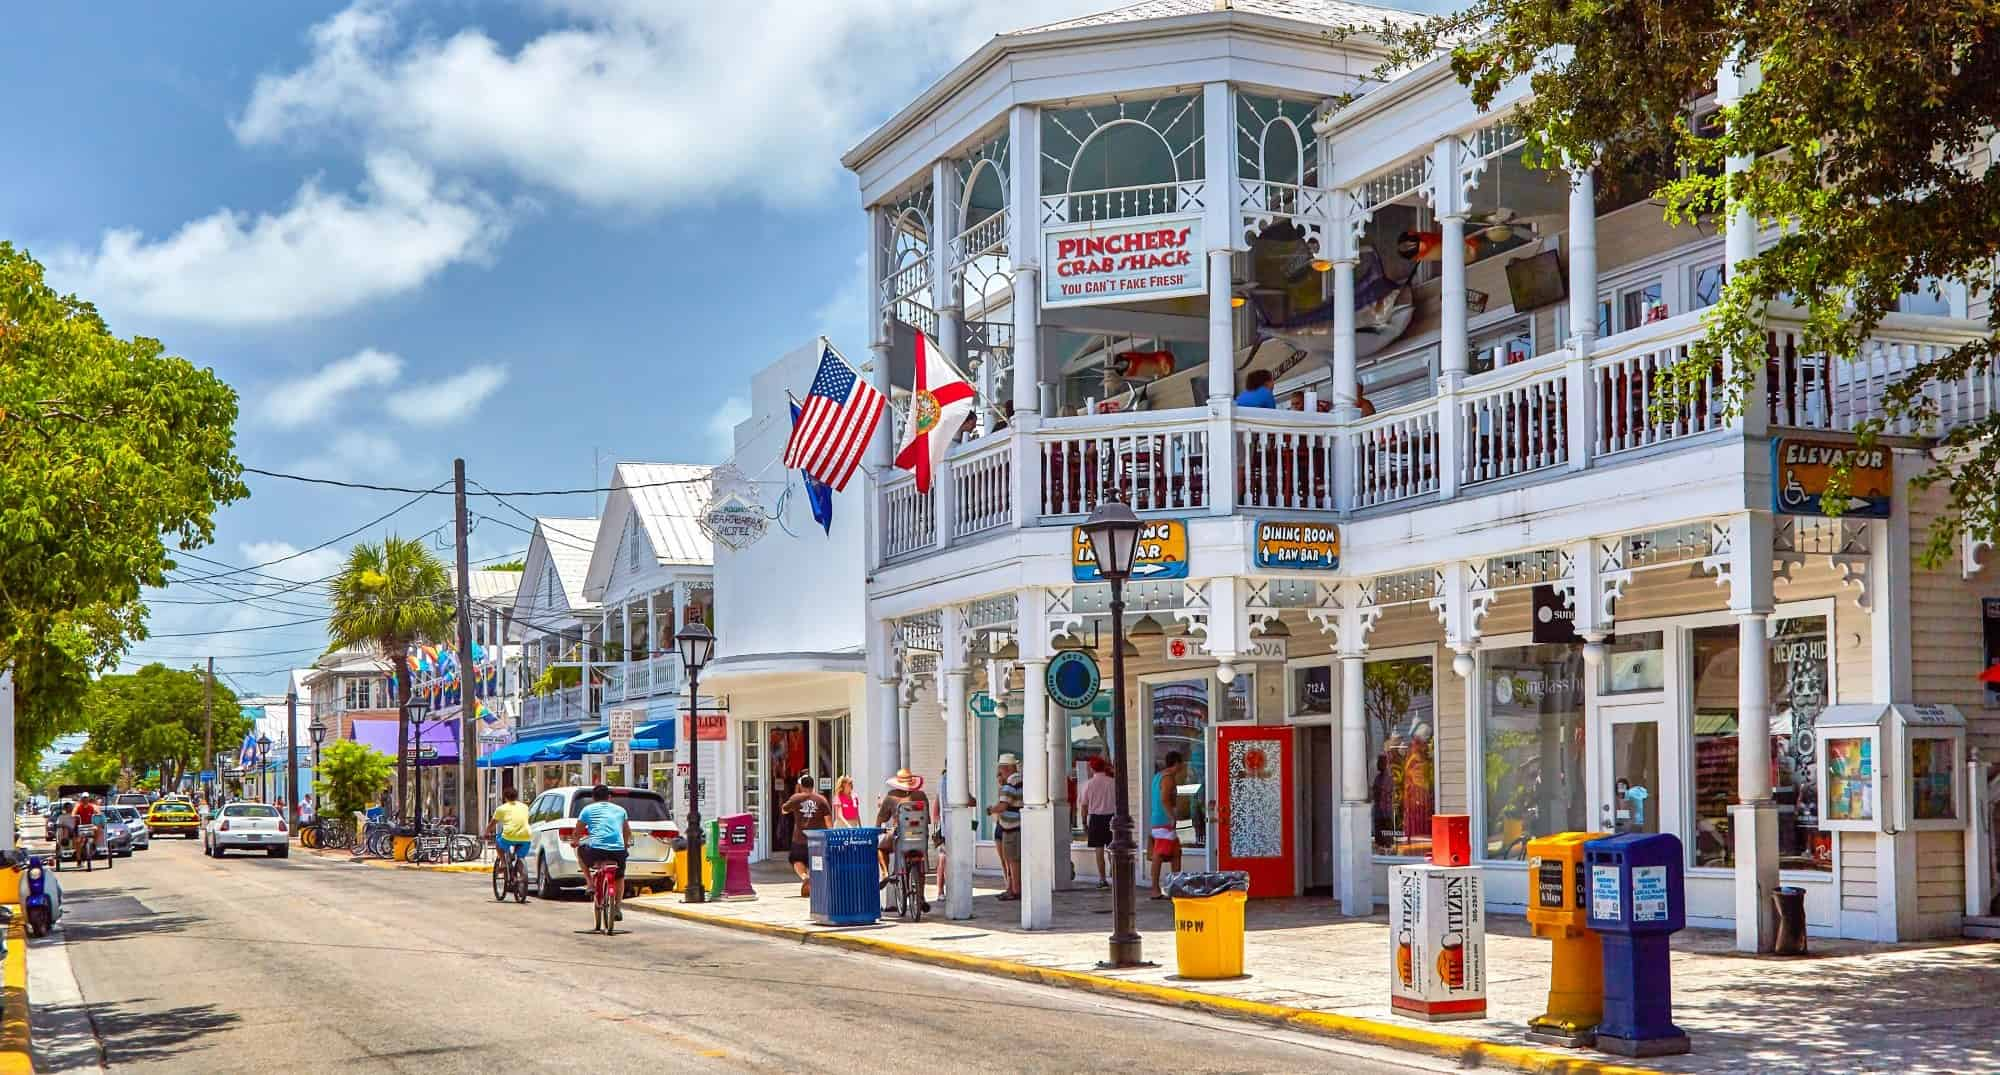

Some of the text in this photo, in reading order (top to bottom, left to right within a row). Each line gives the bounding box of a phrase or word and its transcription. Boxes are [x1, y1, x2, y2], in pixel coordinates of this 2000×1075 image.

[1057, 226, 1191, 260] PINCHERS
[1057, 250, 1192, 277] CRAB SHACK
[1061, 274, 1184, 295] YOU CAN'T FAKE FRESH
[1262, 526, 1335, 543] DINING ROOM
[1278, 548, 1319, 562] RAW BAR
[1774, 642, 1808, 664] NEVER
[1399, 876, 1412, 948] CITIZEN
[1441, 876, 1463, 951] CITIZEN
